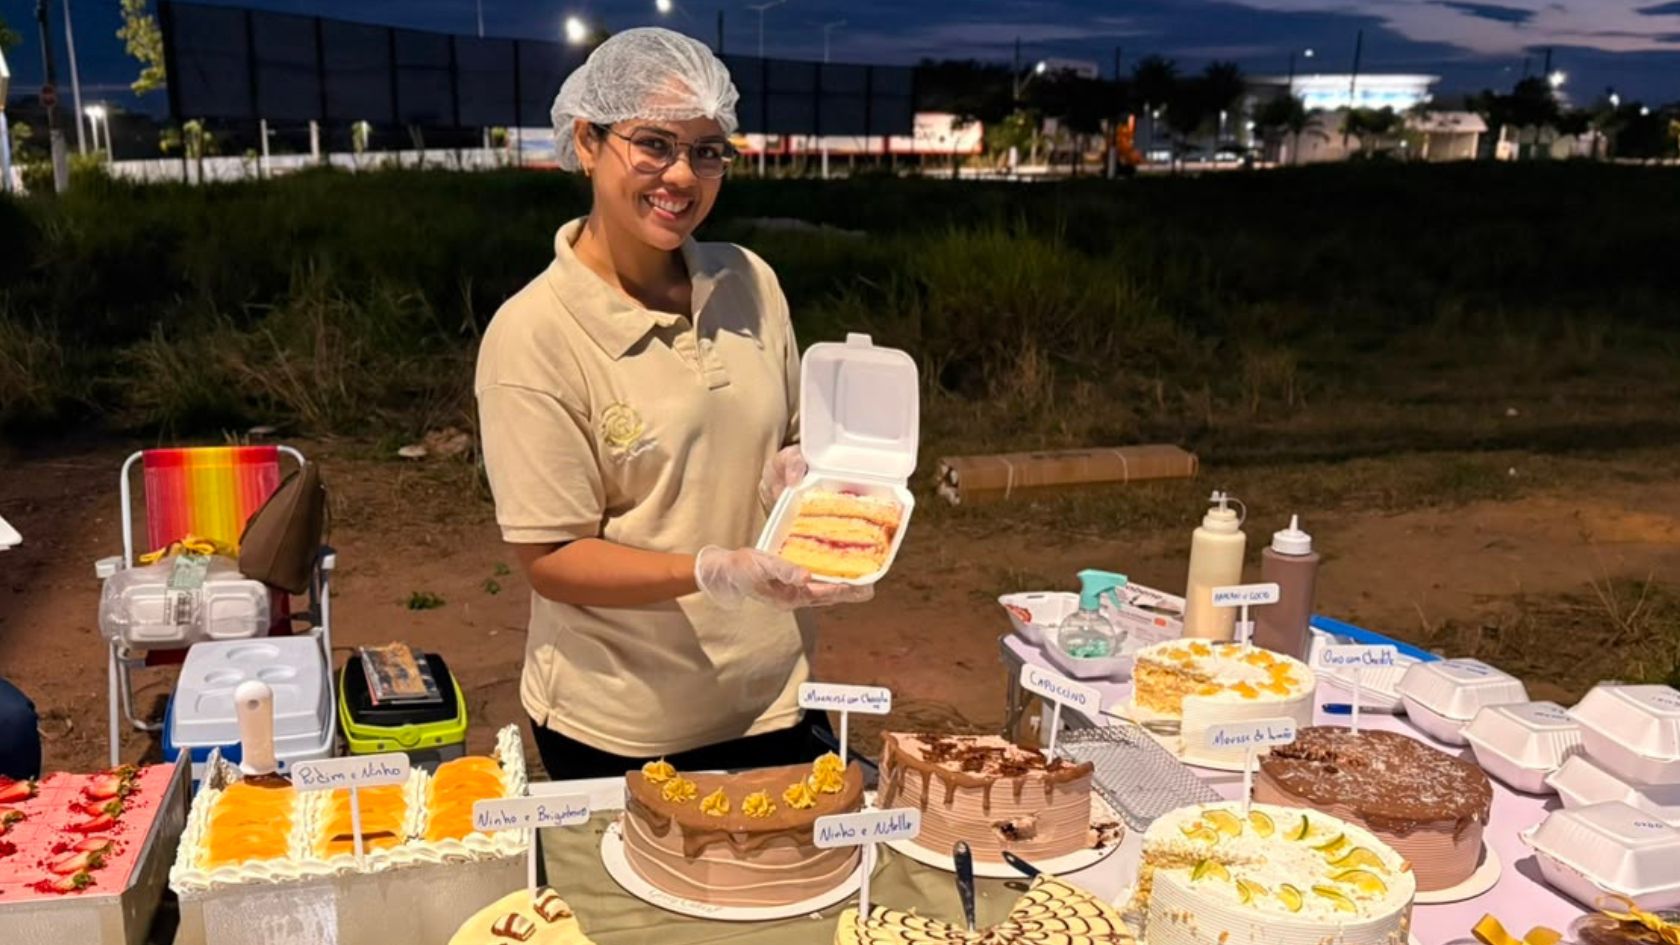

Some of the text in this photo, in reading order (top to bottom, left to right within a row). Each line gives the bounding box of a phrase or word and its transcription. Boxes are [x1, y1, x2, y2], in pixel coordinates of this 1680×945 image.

[1029, 670, 1087, 706] CAPUCCINO
[1211, 729, 1250, 746] Mousse
[361, 761, 401, 779] Ninho
[478, 808, 518, 827] Ninho
[819, 812, 913, 841] Ninho e Nutella
